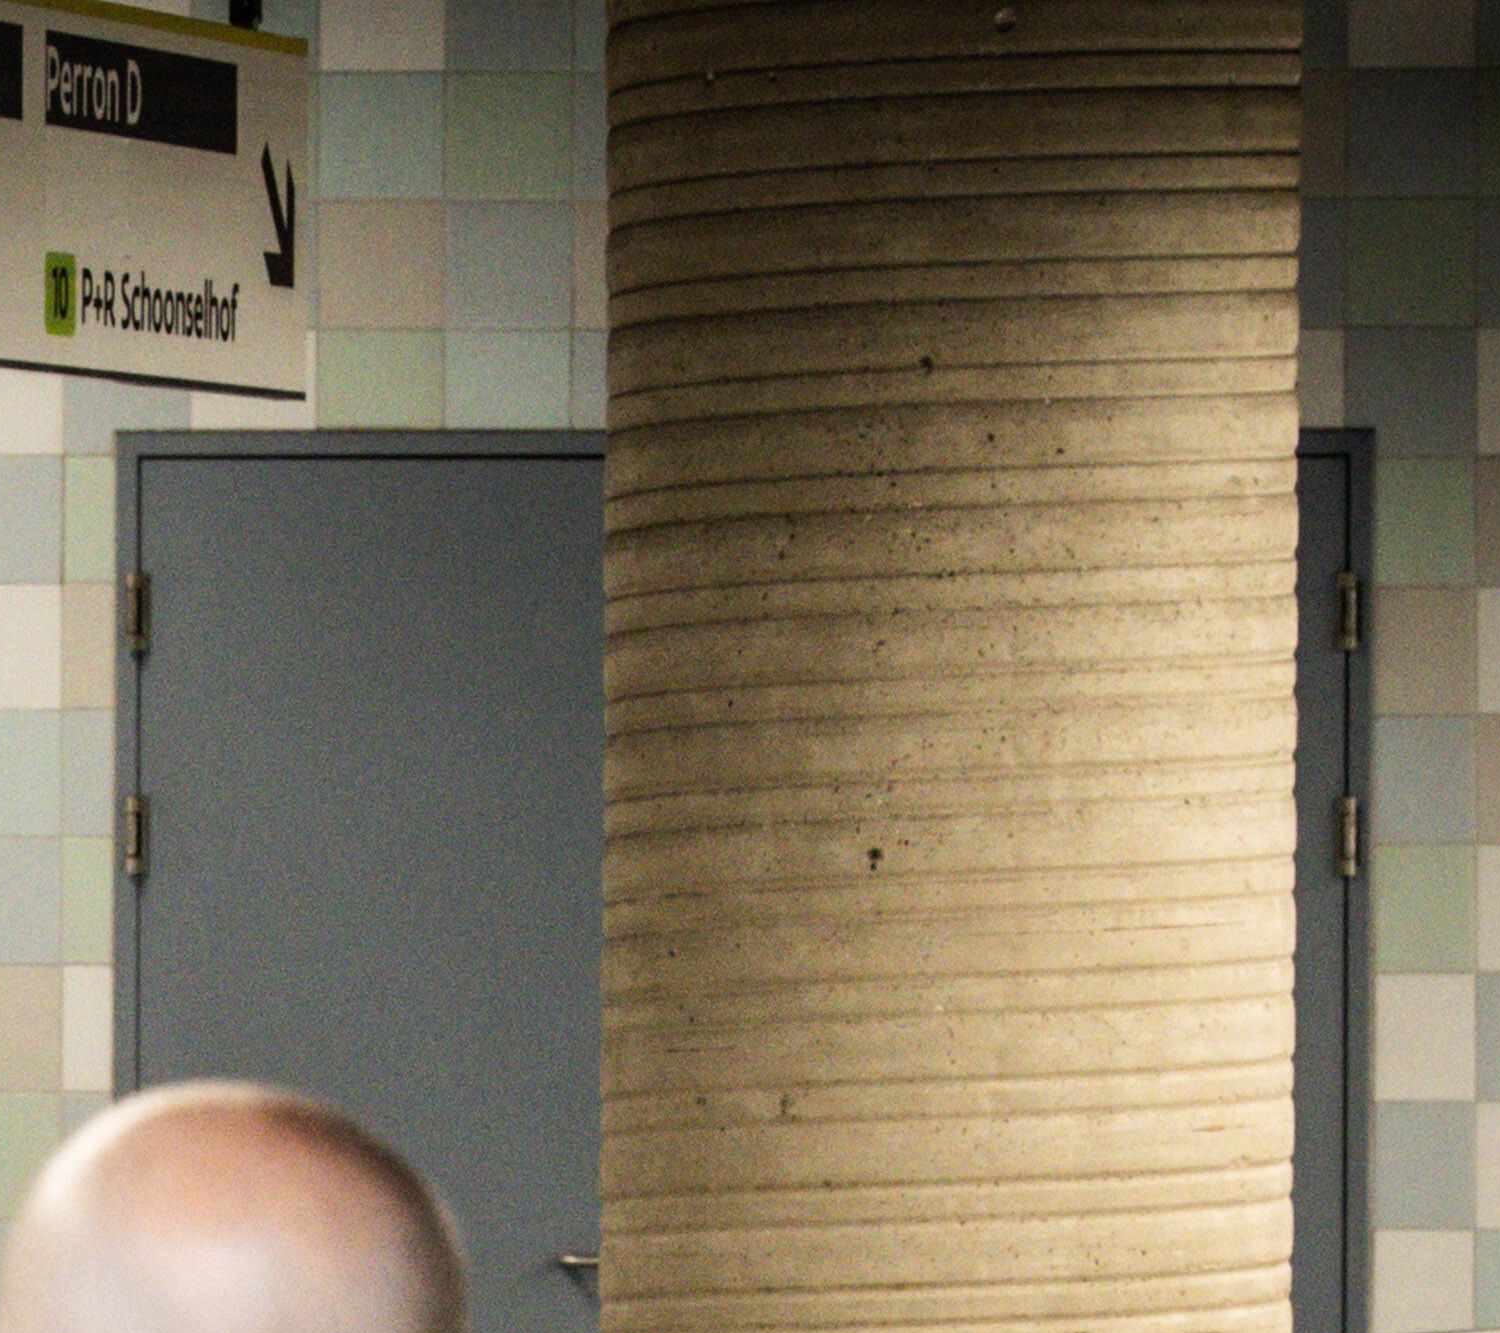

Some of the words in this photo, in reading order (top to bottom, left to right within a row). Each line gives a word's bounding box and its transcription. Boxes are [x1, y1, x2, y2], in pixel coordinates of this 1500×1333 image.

[46, 45, 120, 122] Perron
[126, 59, 142, 125] D
[52, 265, 69, 321] 10
[81, 267, 116, 328] P+R
[121, 270, 240, 342] Schoonselhof
